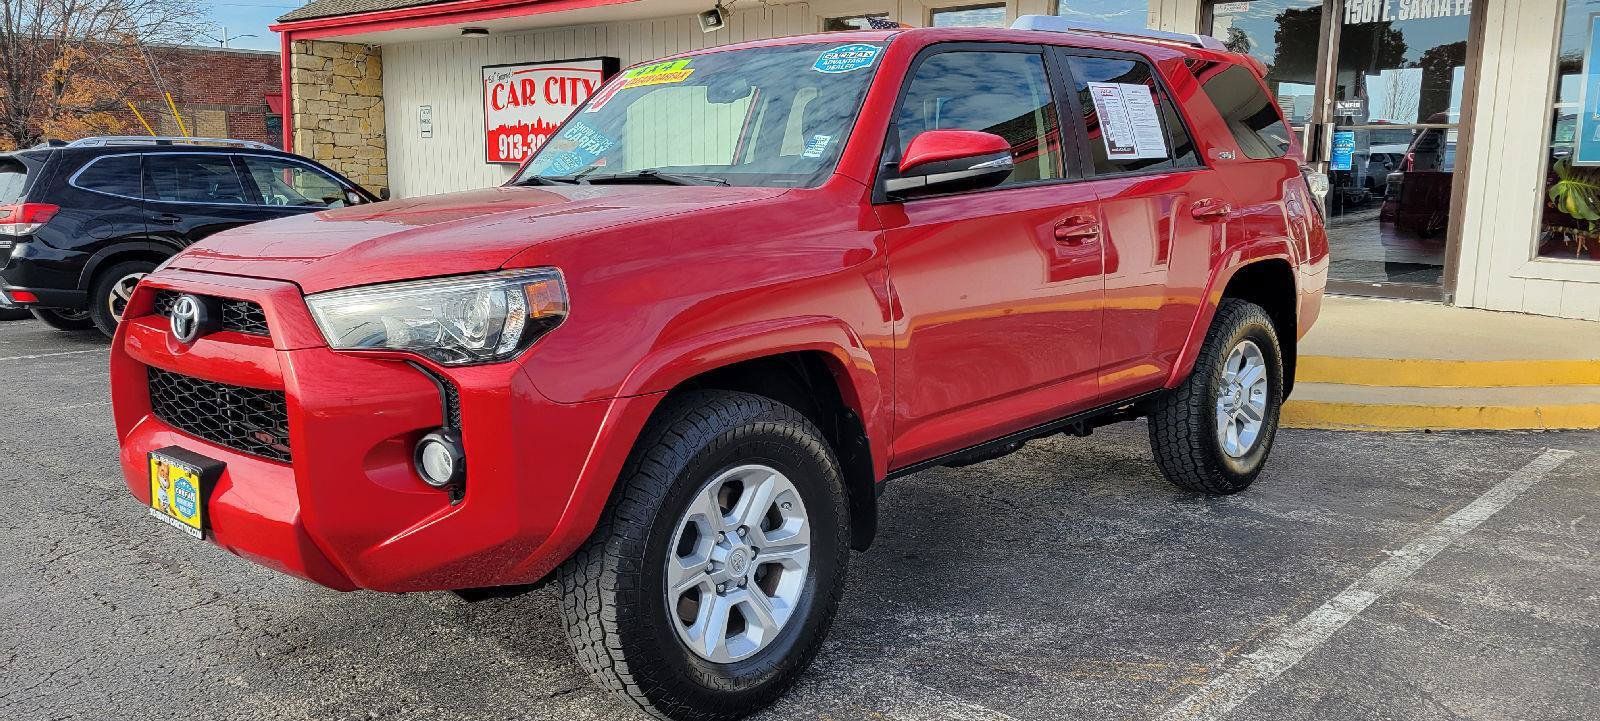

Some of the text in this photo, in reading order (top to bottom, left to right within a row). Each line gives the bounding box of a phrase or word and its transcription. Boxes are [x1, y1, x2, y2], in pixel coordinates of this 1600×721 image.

[1344, 0, 1381, 24] 1501
[1398, 0, 1451, 20] SANTA
[1455, 0, 1472, 16] FE
[491, 78, 536, 111] CAR
[544, 76, 597, 106] CITY
[564, 127, 607, 156] CARFAX
[574, 121, 595, 138] SHOW
[498, 133, 551, 160] 913-30
